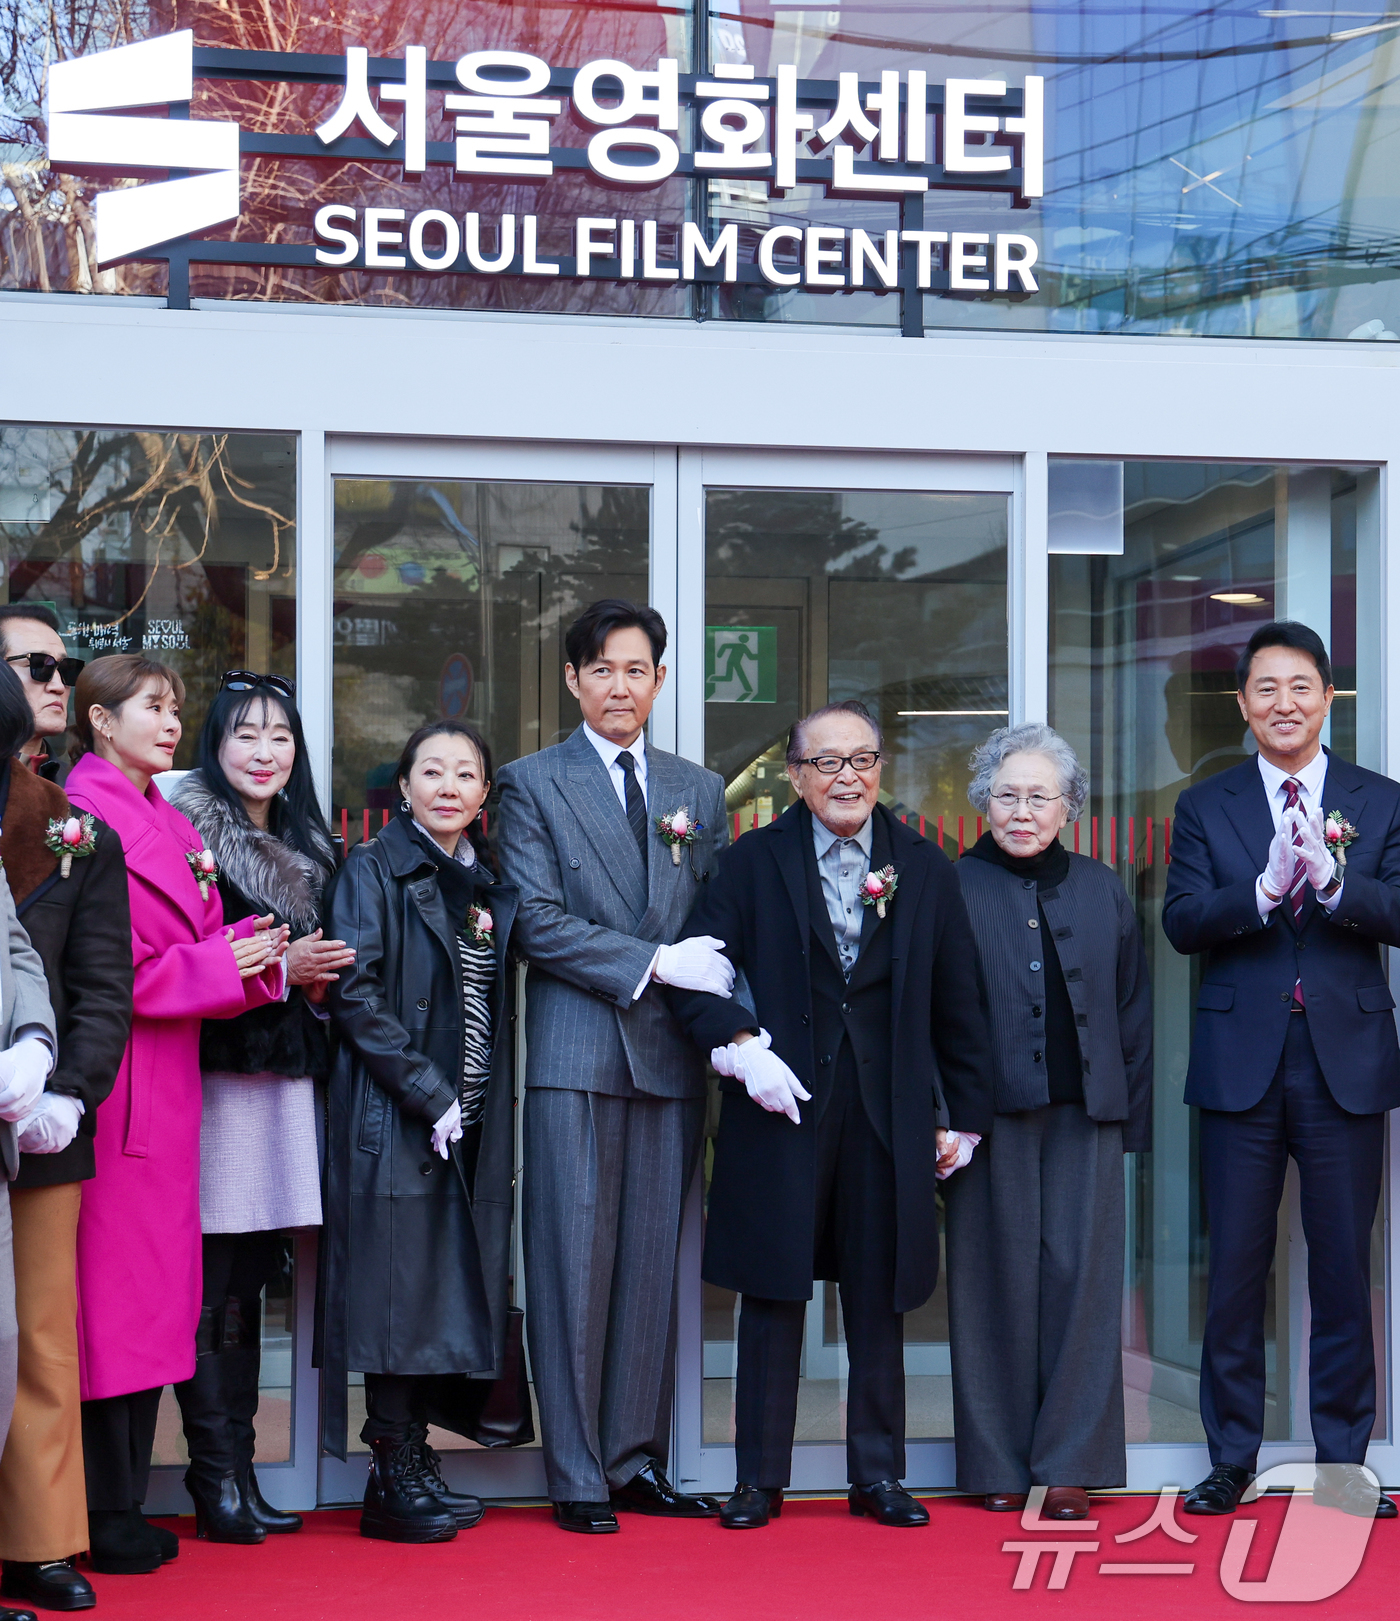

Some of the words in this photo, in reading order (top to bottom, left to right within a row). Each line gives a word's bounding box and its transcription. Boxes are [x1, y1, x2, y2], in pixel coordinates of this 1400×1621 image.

[315, 45, 1045, 198] 서울영화센터
[314, 203, 561, 276] SEOUL
[576, 216, 739, 283] FILM
[759, 224, 1040, 293] CENTER
[162, 634, 192, 651] SOUL
